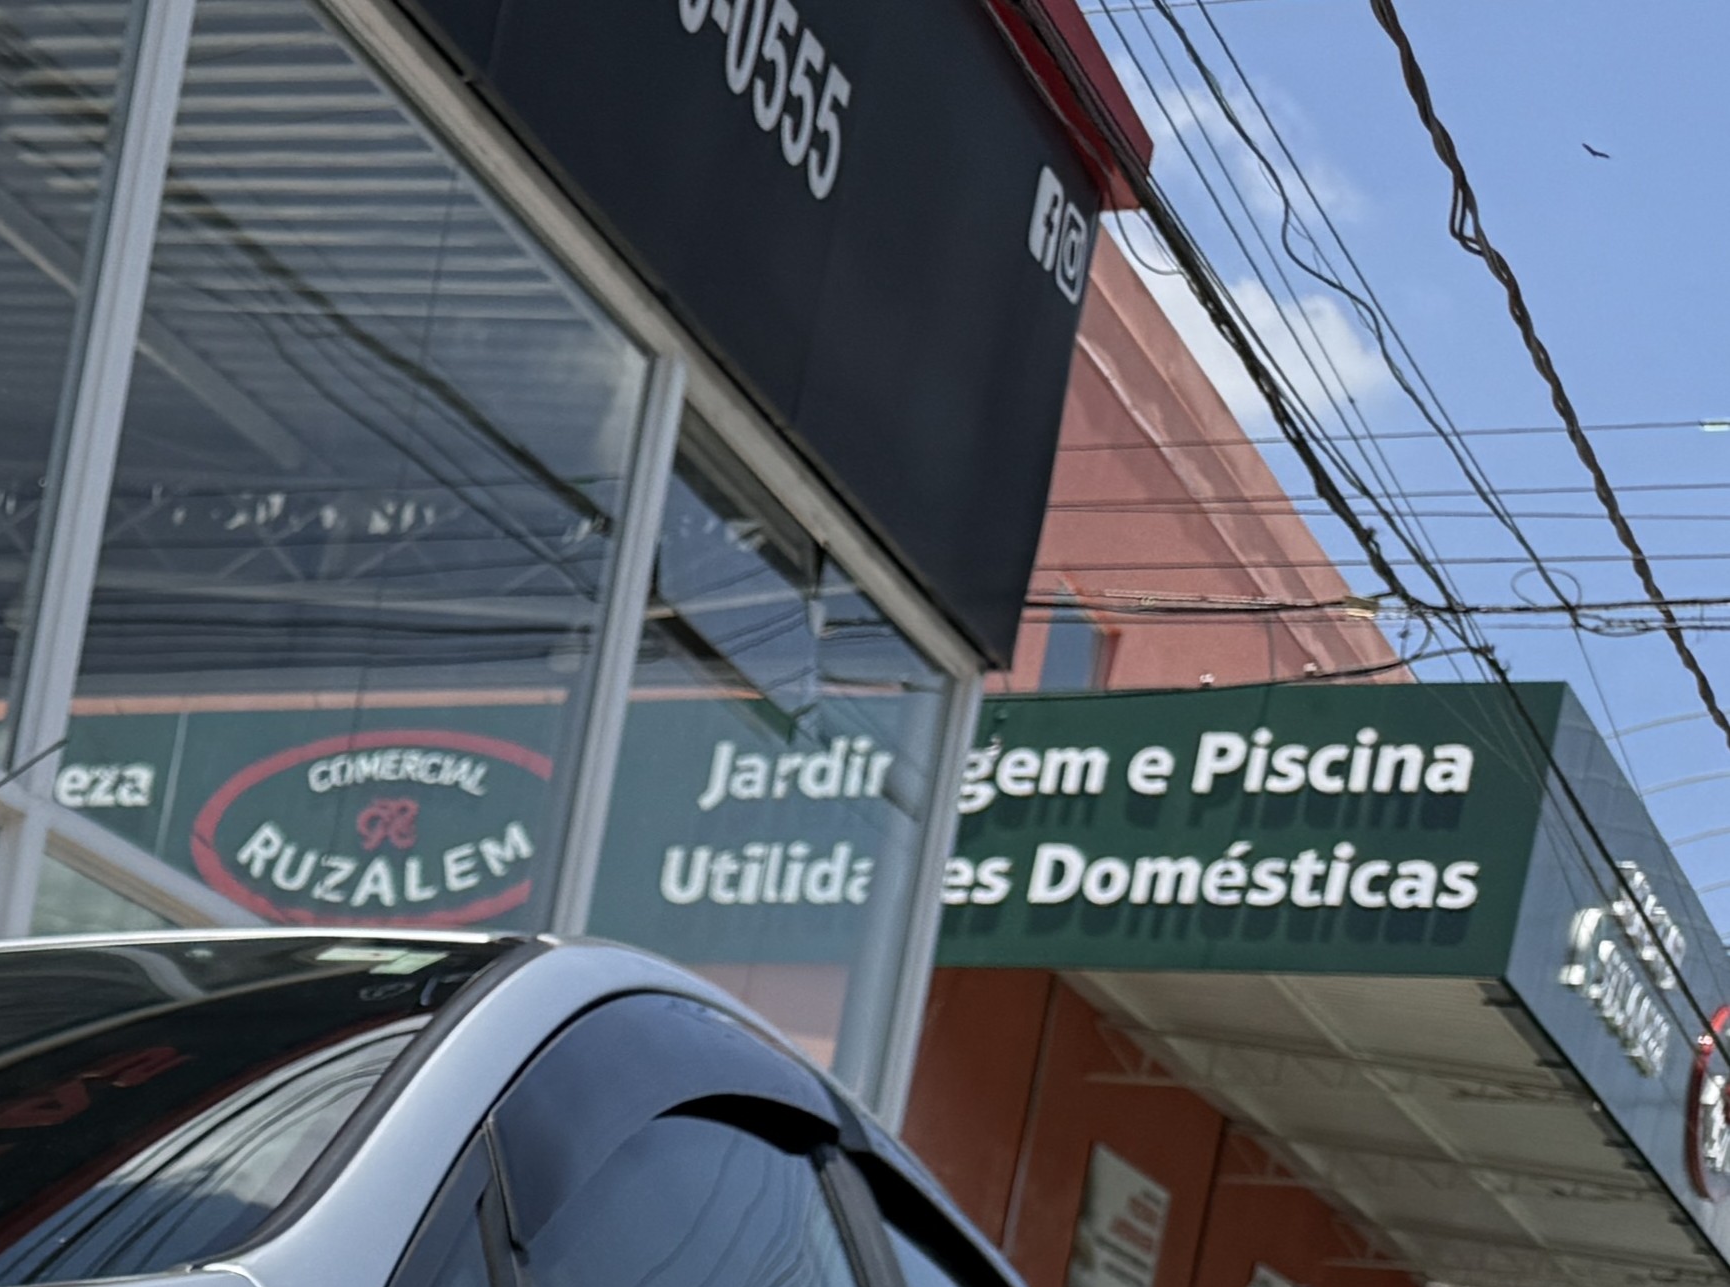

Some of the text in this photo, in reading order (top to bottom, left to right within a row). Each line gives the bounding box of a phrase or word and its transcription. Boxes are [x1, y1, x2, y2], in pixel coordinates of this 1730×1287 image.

[678, 0, 852, 200] -0555
[307, 749, 487, 796] COMERCIAL
[1127, 746, 1175, 795] e
[1191, 727, 1474, 794] Piscina
[237, 820, 535, 907] RUZALEM
[1026, 840, 1480, 909] Domésticas
